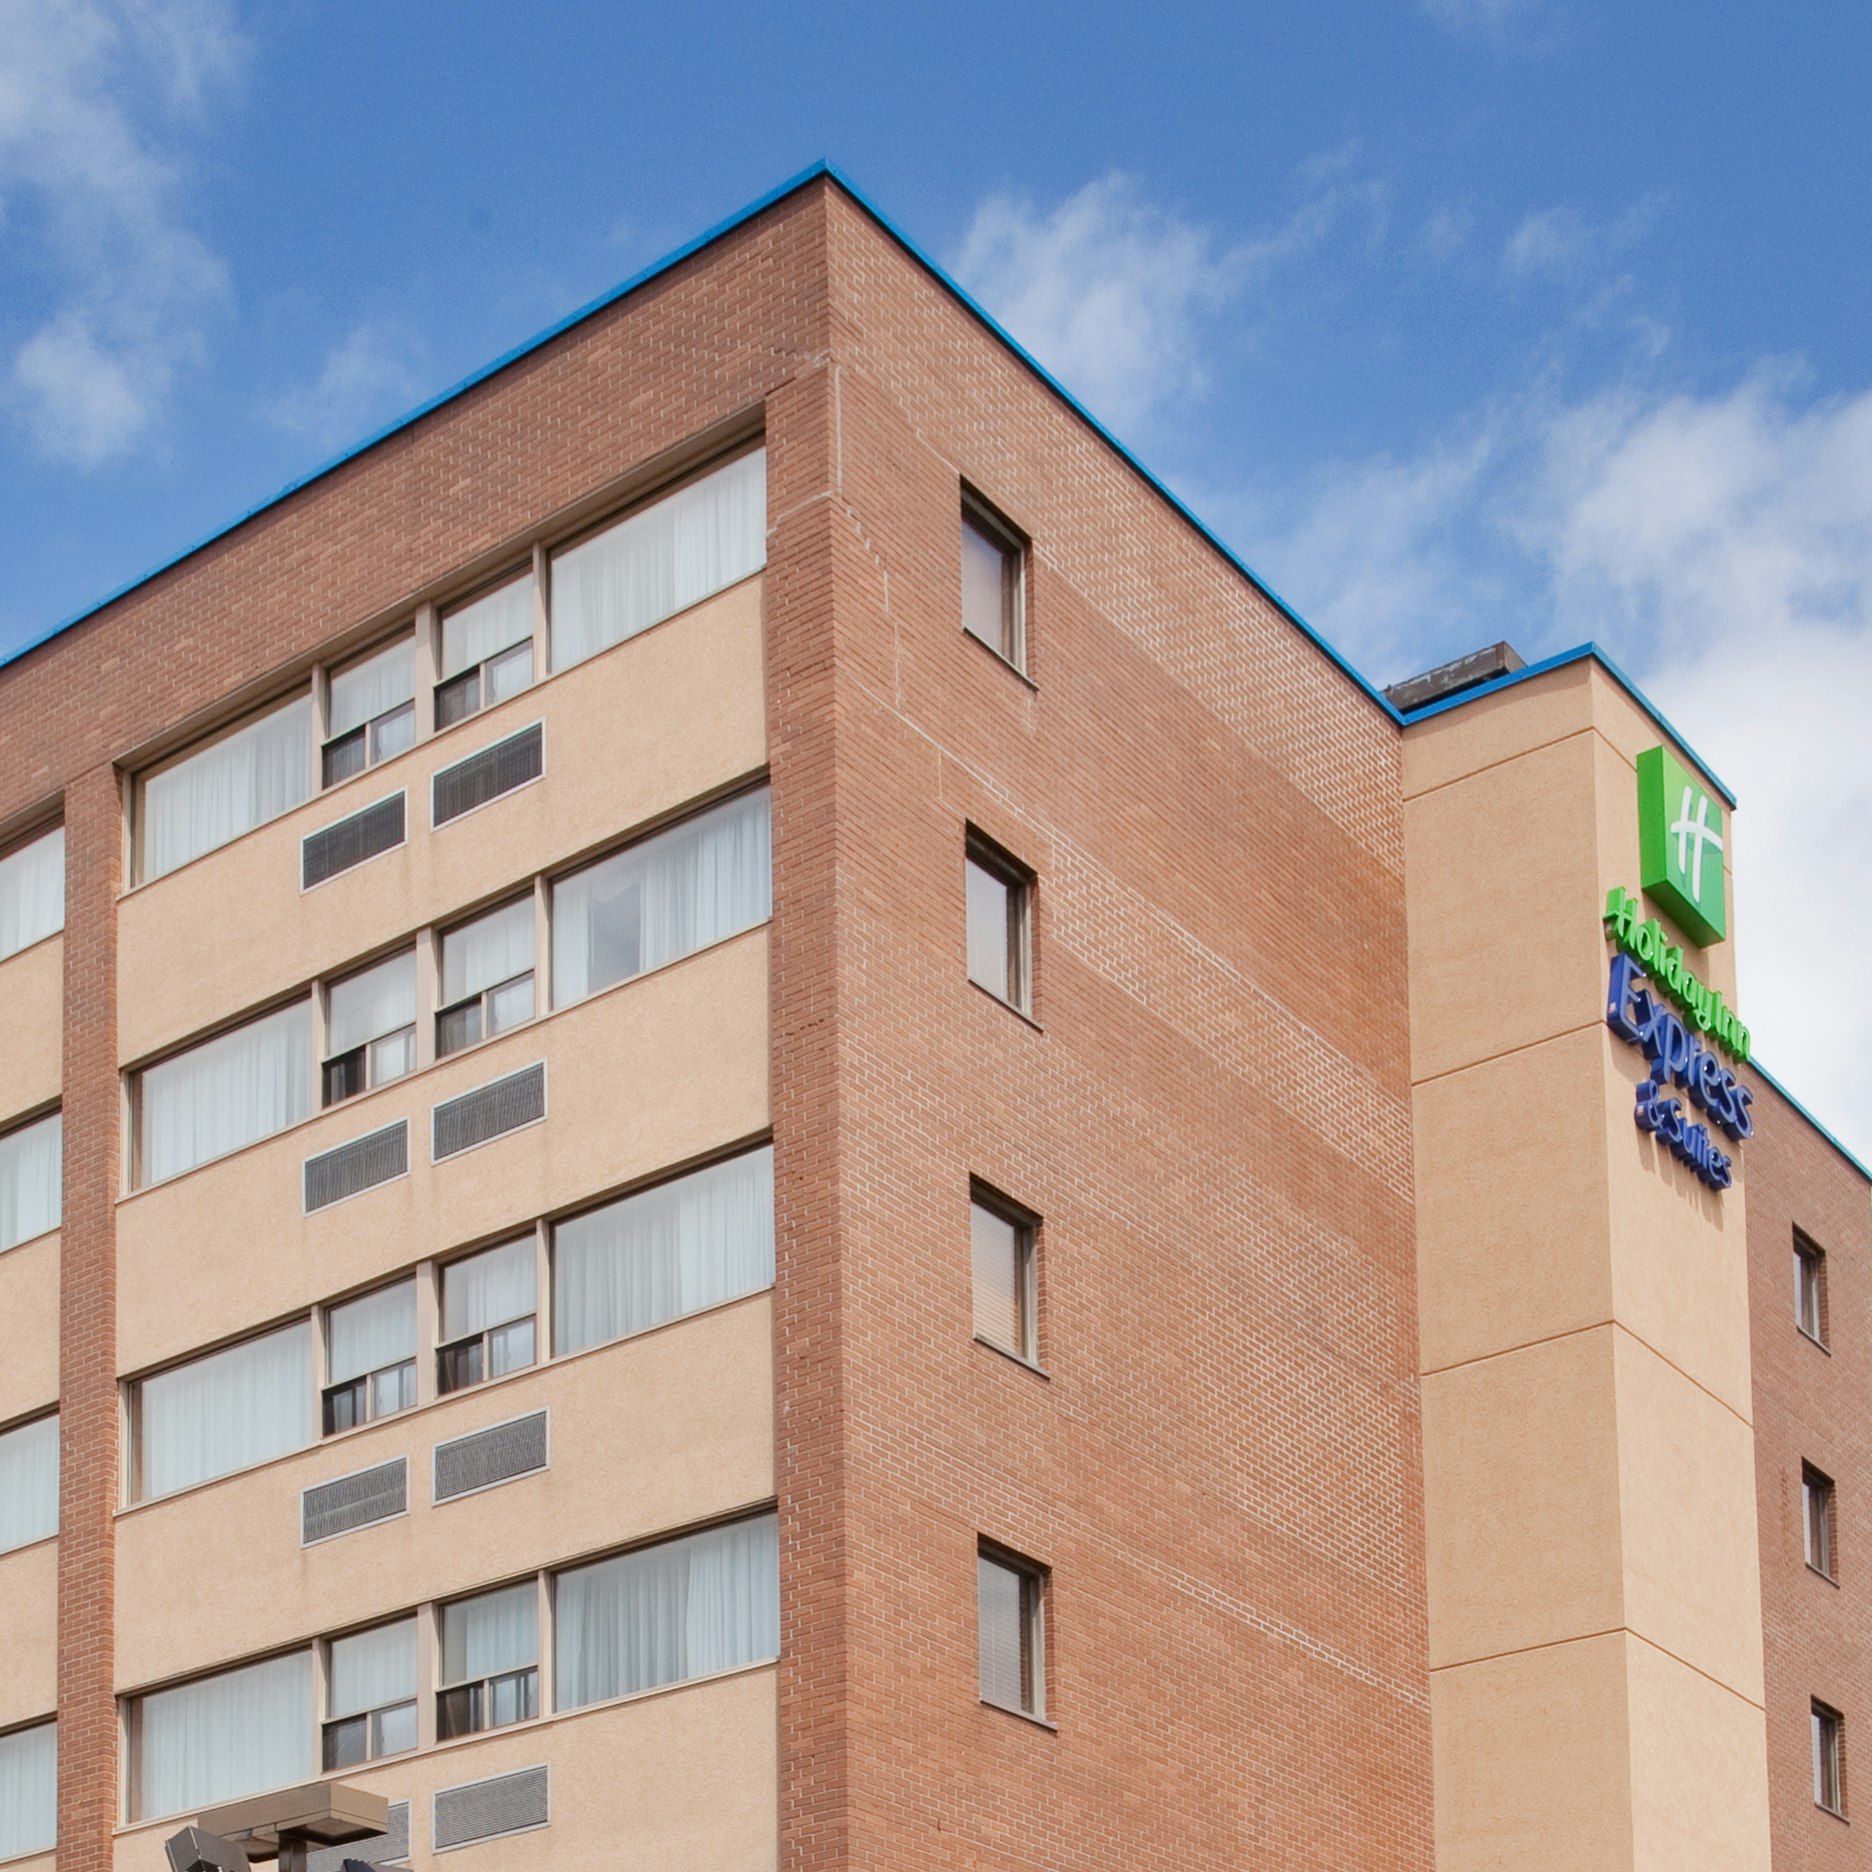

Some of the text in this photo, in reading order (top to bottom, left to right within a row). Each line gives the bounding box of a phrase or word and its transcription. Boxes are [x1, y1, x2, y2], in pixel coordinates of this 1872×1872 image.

[1603, 886, 1751, 1063] Holiday Inn
[1607, 952, 1754, 1141] Express
[1634, 1079, 1732, 1191] & Suites
